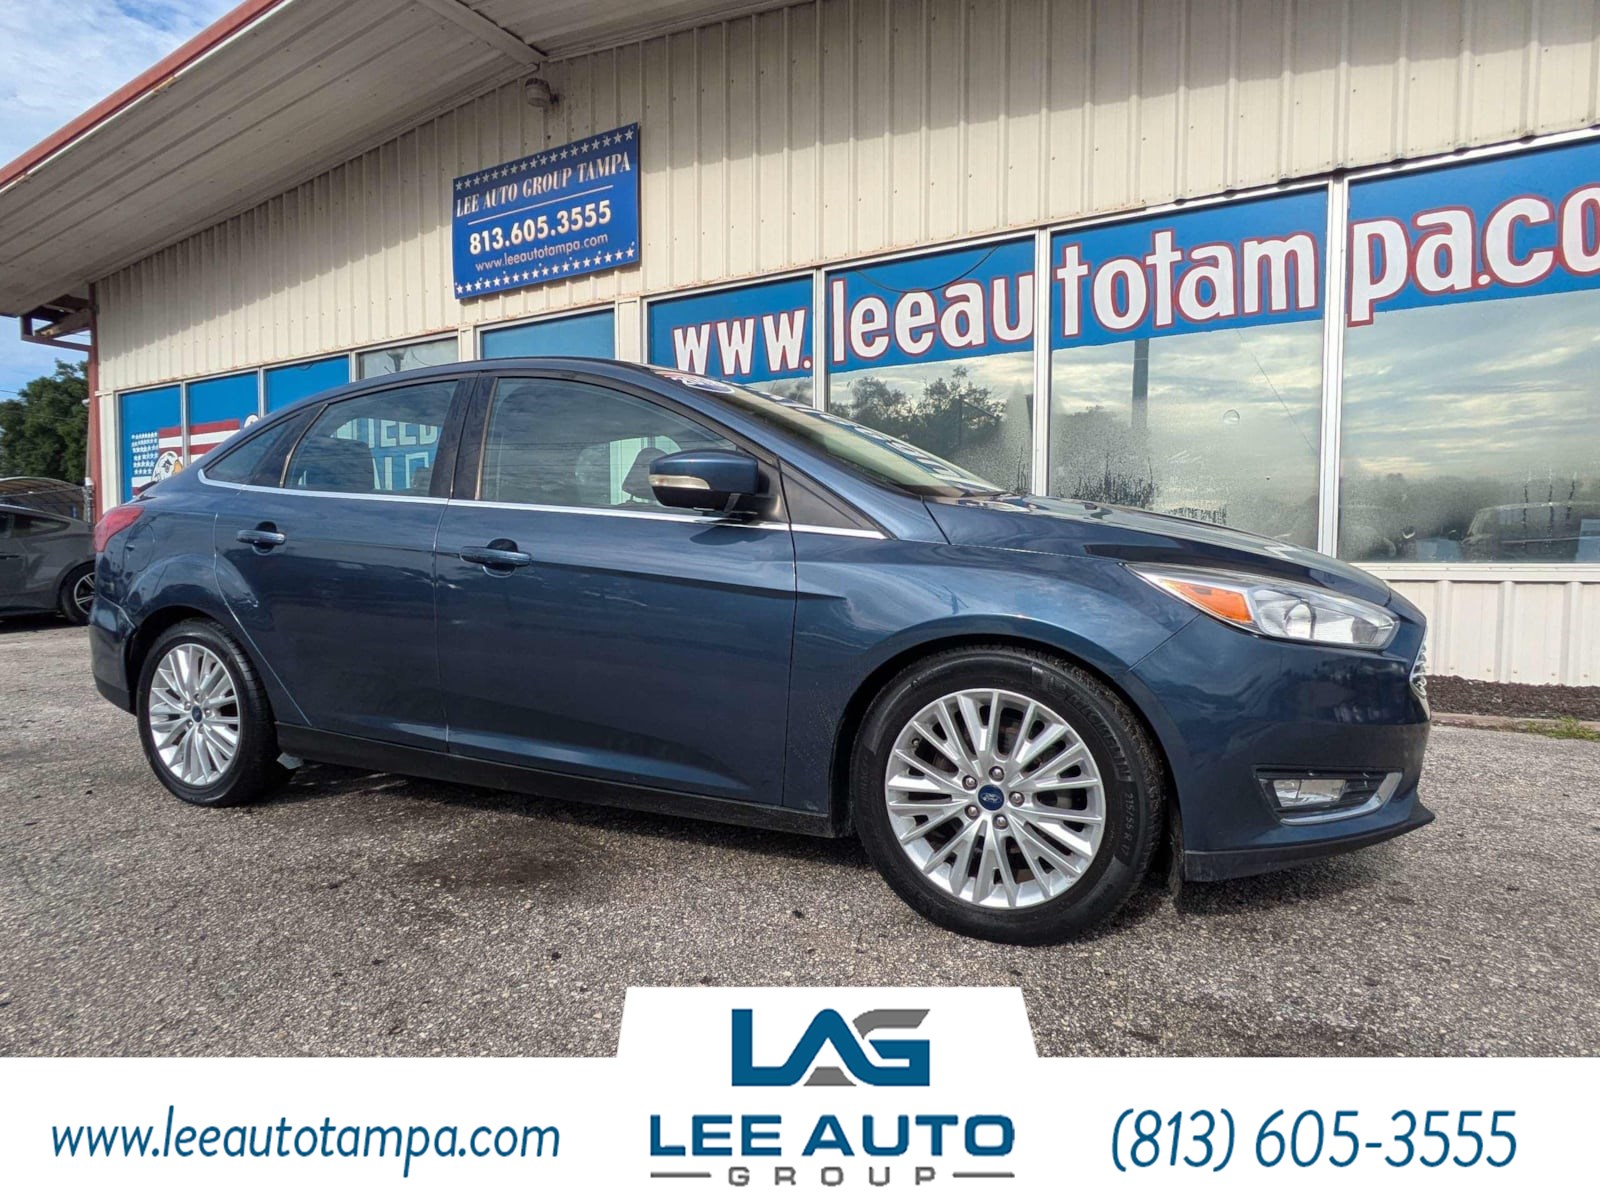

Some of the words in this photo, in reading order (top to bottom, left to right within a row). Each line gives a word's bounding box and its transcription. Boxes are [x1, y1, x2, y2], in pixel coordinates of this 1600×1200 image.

[456, 189, 480, 218] LEE
[483, 182, 518, 210] AUTO
[522, 166, 572, 196] GROUP
[577, 151, 631, 184] TAMPA
[469, 199, 612, 255] 813.605.3555
[475, 233, 609, 272] www.leeautotampa.com
